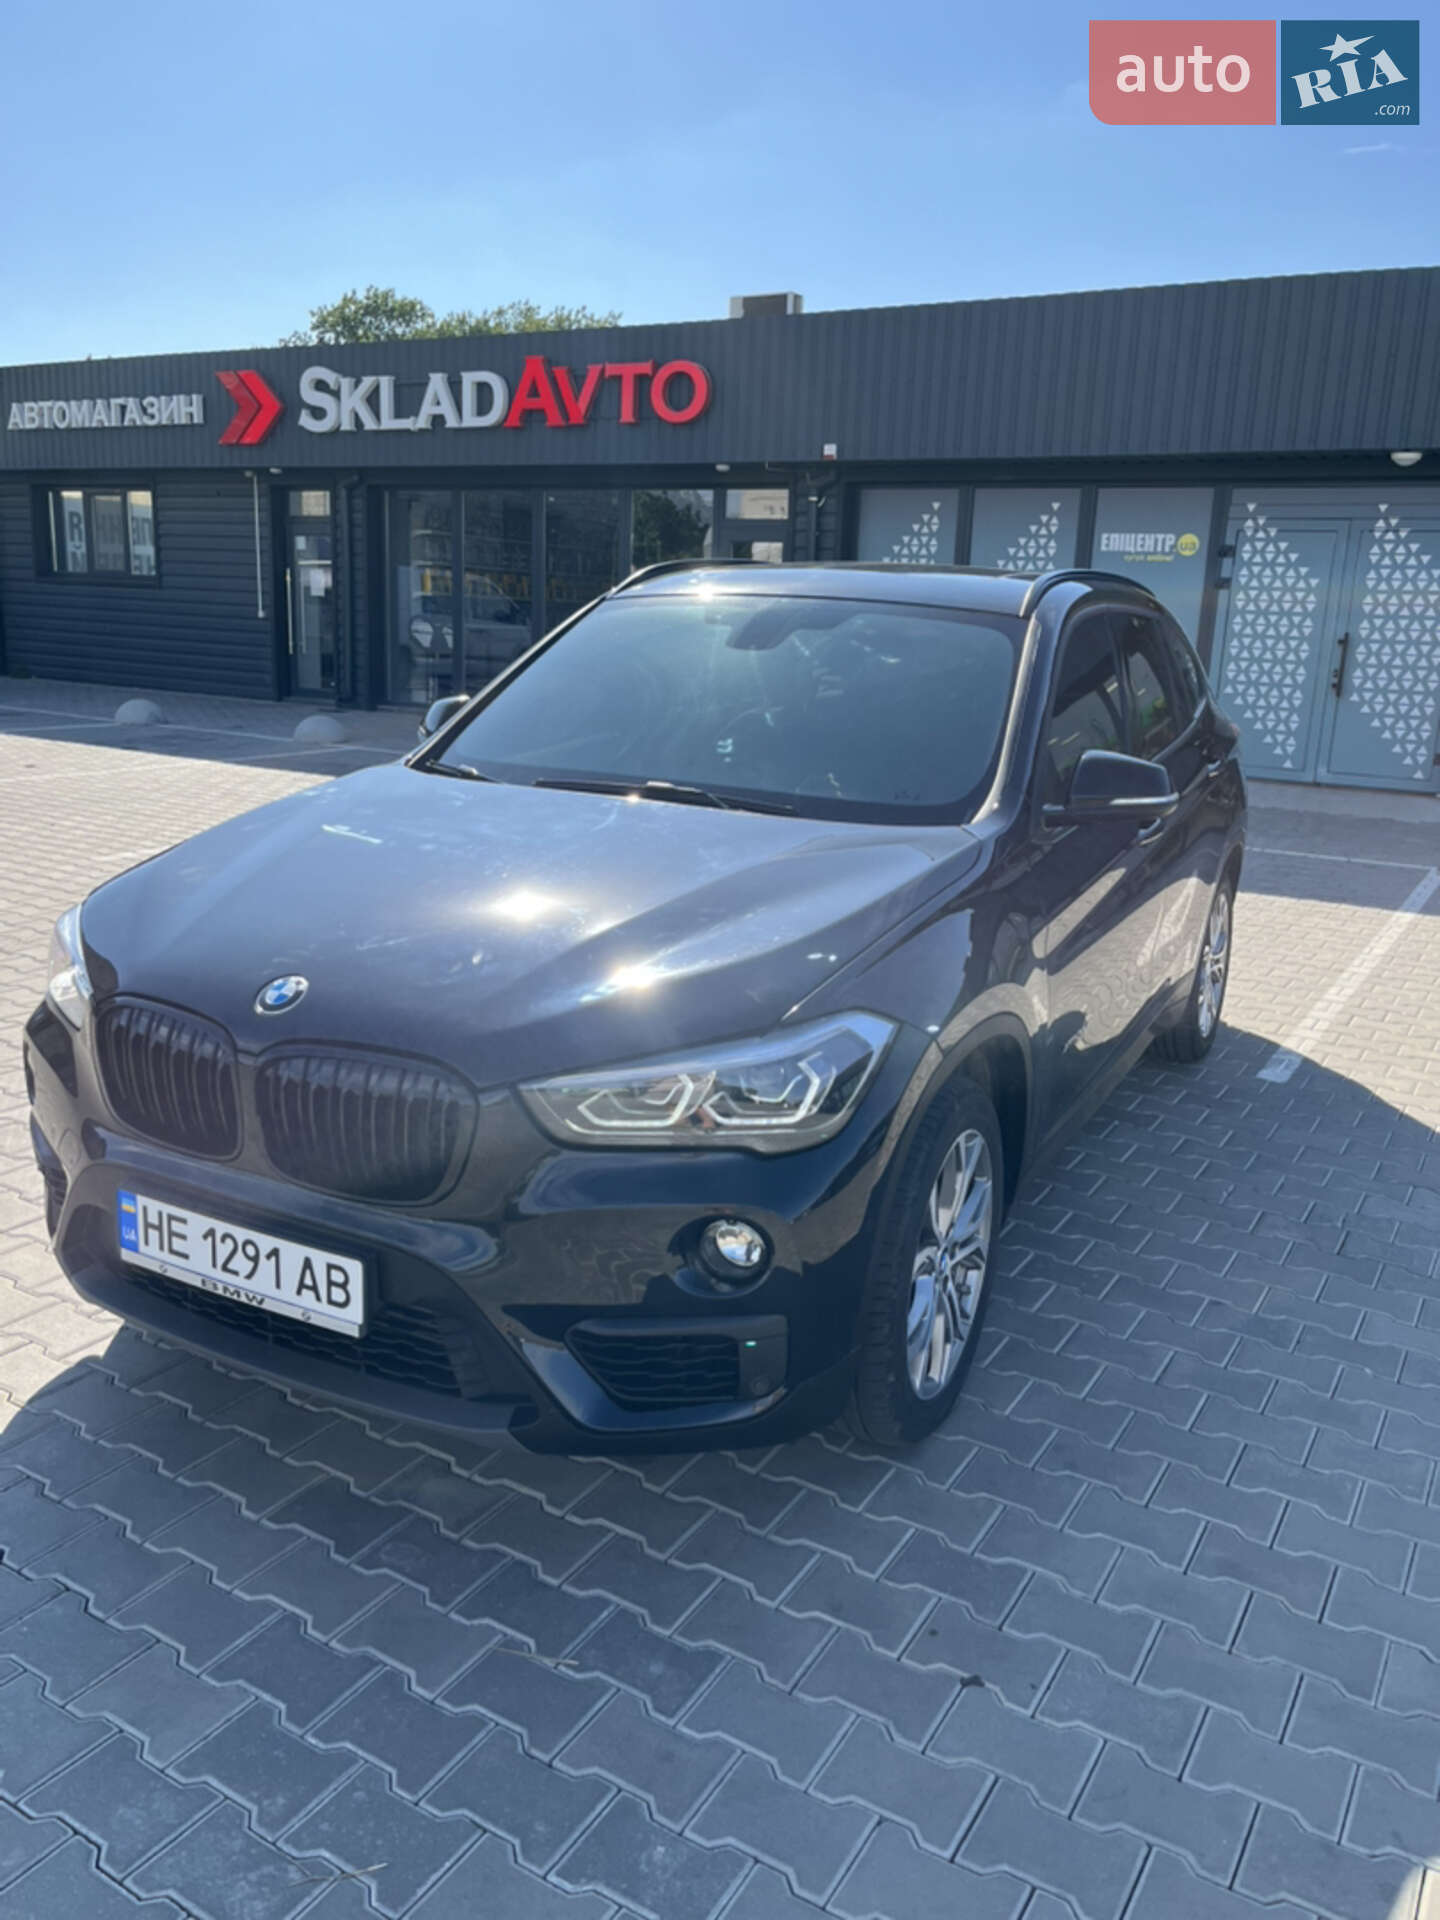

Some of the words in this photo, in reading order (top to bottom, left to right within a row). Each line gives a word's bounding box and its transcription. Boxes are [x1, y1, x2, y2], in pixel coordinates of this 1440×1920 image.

[7, 394, 204, 430] АВТОМАГАЗИН
[142, 1205, 190, 1260] HE
[202, 1227, 282, 1290] 1291
[296, 1256, 352, 1309] AB
